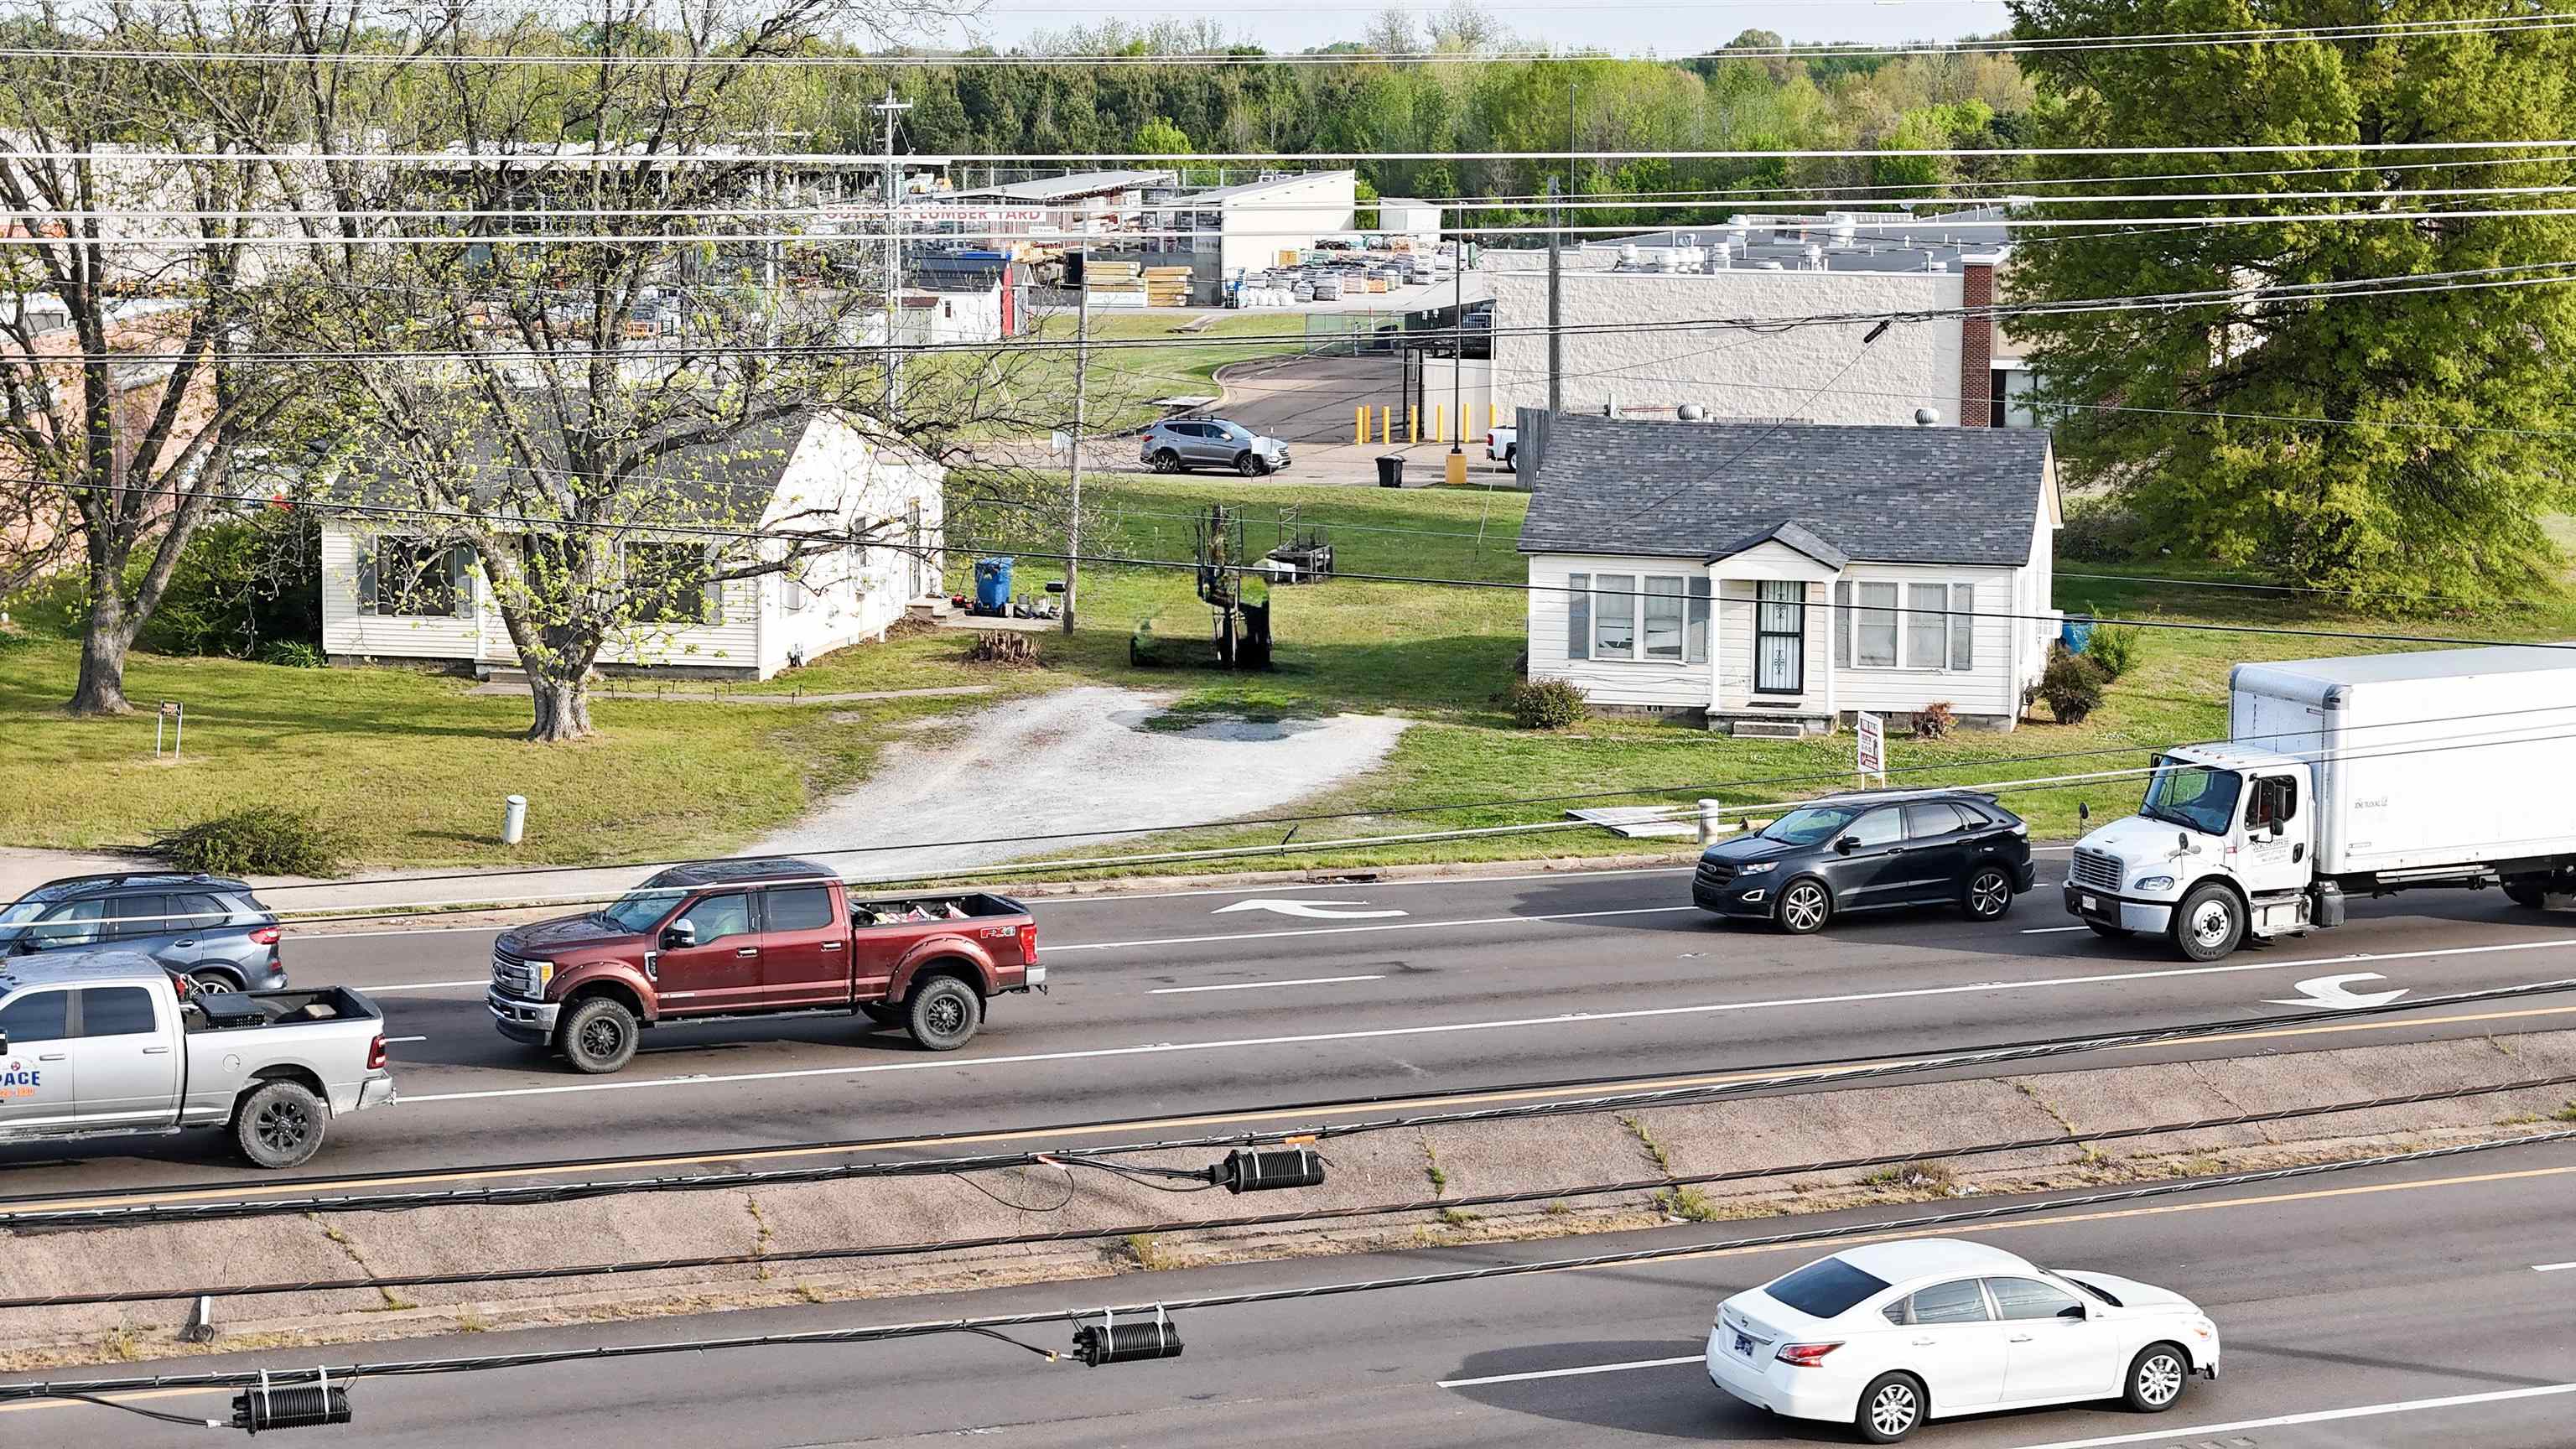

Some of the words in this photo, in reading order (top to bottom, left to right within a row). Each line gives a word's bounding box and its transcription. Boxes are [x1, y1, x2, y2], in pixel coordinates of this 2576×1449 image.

[920, 206, 988, 220] LUMBER
[995, 206, 1041, 220] YARD
[980, 926, 1015, 938] FX4
